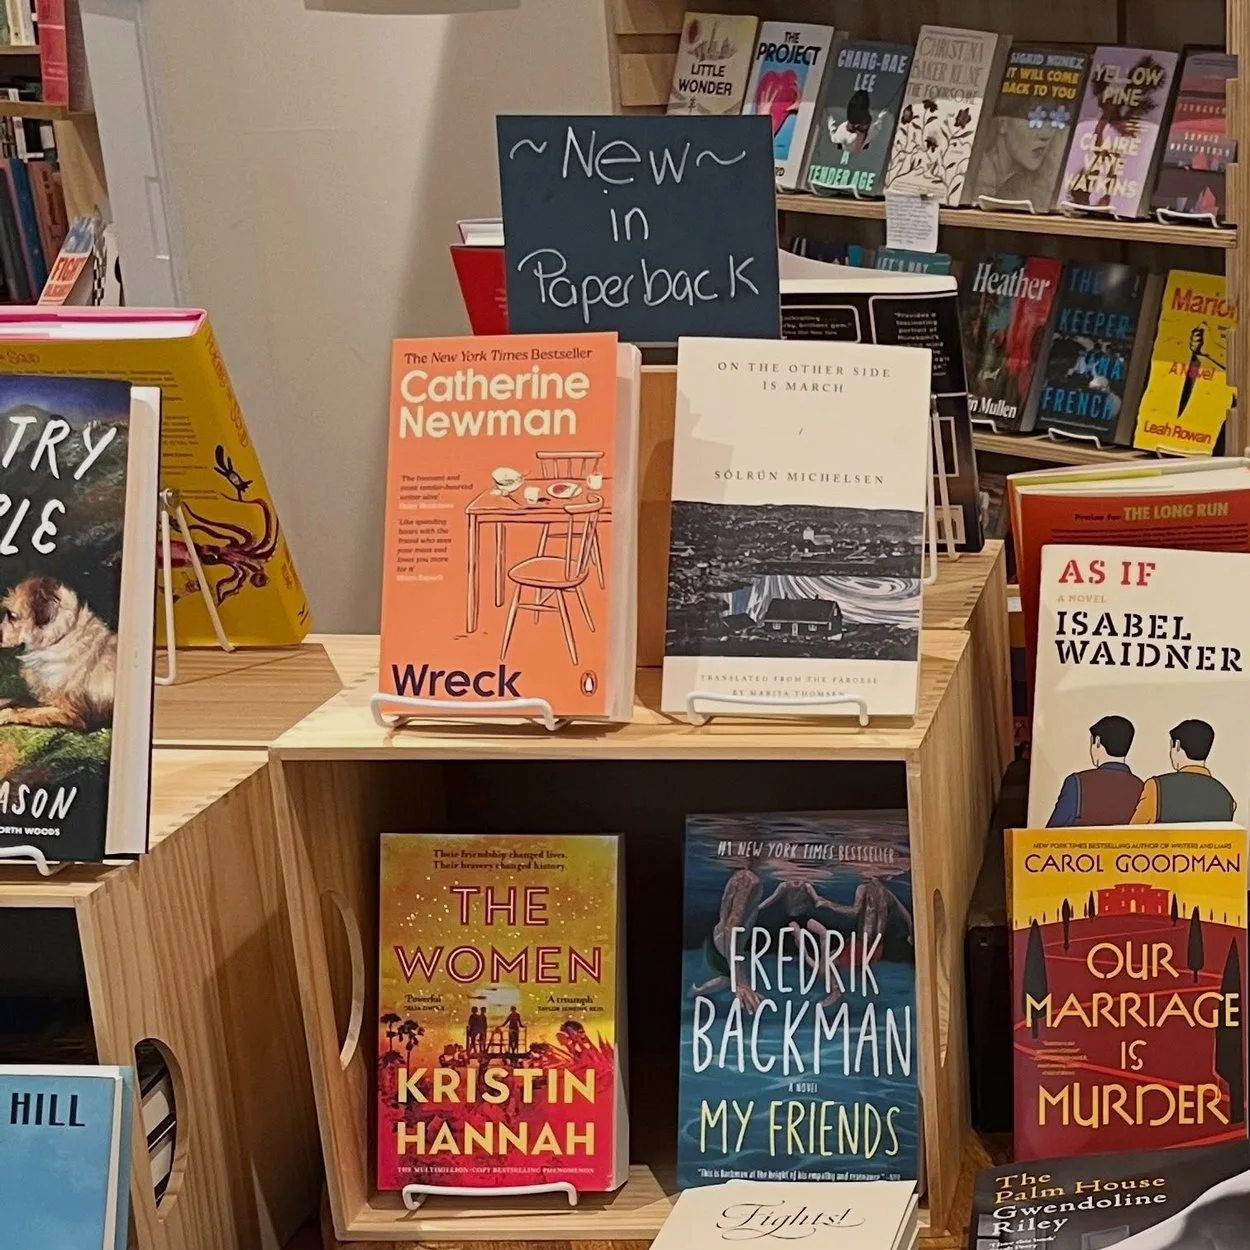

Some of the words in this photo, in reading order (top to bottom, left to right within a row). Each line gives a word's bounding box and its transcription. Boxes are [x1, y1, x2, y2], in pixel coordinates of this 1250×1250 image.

[785, 32, 800, 43] THE
[757, 43, 822, 66] PROJECT
[837, 49, 909, 74] CHANG-RAE
[1010, 52, 1044, 65] SIGRID
[691, 64, 726, 78] LITTLE
[854, 74, 877, 92] LEE
[1006, 67, 1017, 78] IT
[1019, 68, 1044, 81] WILL
[1047, 70, 1080, 84] COME
[1093, 63, 1163, 87] YELLOW
[678, 79, 733, 96] WONDER
[1002, 81, 1031, 95] BACK
[1033, 84, 1047, 97] TO
[1051, 85, 1077, 99] YOU
[1102, 88, 1142, 107] PINE
[563, 126, 691, 185] New
[1080, 132, 1141, 156] CLAIRE
[850, 170, 877, 192] AGE
[1064, 172, 1139, 198] WATKINS
[602, 189, 649, 242] in
[517, 248, 759, 324] Paperback
[973, 263, 1051, 300] Heather
[1059, 309, 1134, 337] KEEPER
[404, 353, 428, 364] The
[431, 352, 457, 363] New
[460, 350, 487, 362] York
[491, 349, 528, 361] Times
[531, 348, 592, 360] Bestseller
[718, 361, 740, 371] ON
[748, 362, 780, 373] THE
[789, 364, 844, 376] OTHER
[853, 367, 891, 378] SIDE
[400, 365, 590, 404] Catherine
[763, 381, 778, 390] IS
[786, 382, 844, 393] MARCH
[978, 395, 1018, 420] Mullen
[1042, 388, 1114, 421] FRENCH
[399, 406, 577, 439] Newman
[1144, 420, 1171, 436] Leah
[1172, 425, 1211, 444] Rowan
[787, 471, 885, 485] MICHELSEN
[1123, 506, 1150, 522] THE
[1154, 504, 1194, 520] LONG
[1197, 502, 1229, 518] RUN
[1058, 559, 1107, 585] AS
[1120, 561, 1157, 587] IF
[1056, 611, 1192, 641] ISABEL
[1055, 640, 1243, 672] WAIDNER
[391, 664, 522, 697] Wreck
[24, 828, 60, 836] WOODS
[1024, 853, 1104, 873] CAROL
[1115, 853, 1241, 874] GOODMAN
[450, 885, 549, 926] THE
[393, 945, 602, 984] WOMEN
[730, 926, 882, 997] FREDRIK
[1086, 941, 1180, 981] OUR
[1025, 992, 1240, 1029] MARRIAGE
[692, 995, 911, 1078] BACKMAN
[1120, 1039, 1147, 1071] IS
[397, 1067, 595, 1105] KRISTIN
[11, 1093, 85, 1127] HILL
[1039, 1082, 1230, 1129] MURDER
[396, 1121, 595, 1156] HANNAH
[700, 1100, 754, 1154] MY
[769, 1100, 900, 1160] FRIENDS
[994, 1186, 1064, 1205] Palm
[1074, 1176, 1166, 1195] House
[995, 1172, 1052, 1190] The
[992, 1192, 1167, 1220] Gwendoline
[716, 1200, 866, 1241] Fights!
[991, 1217, 1069, 1237] Riley
